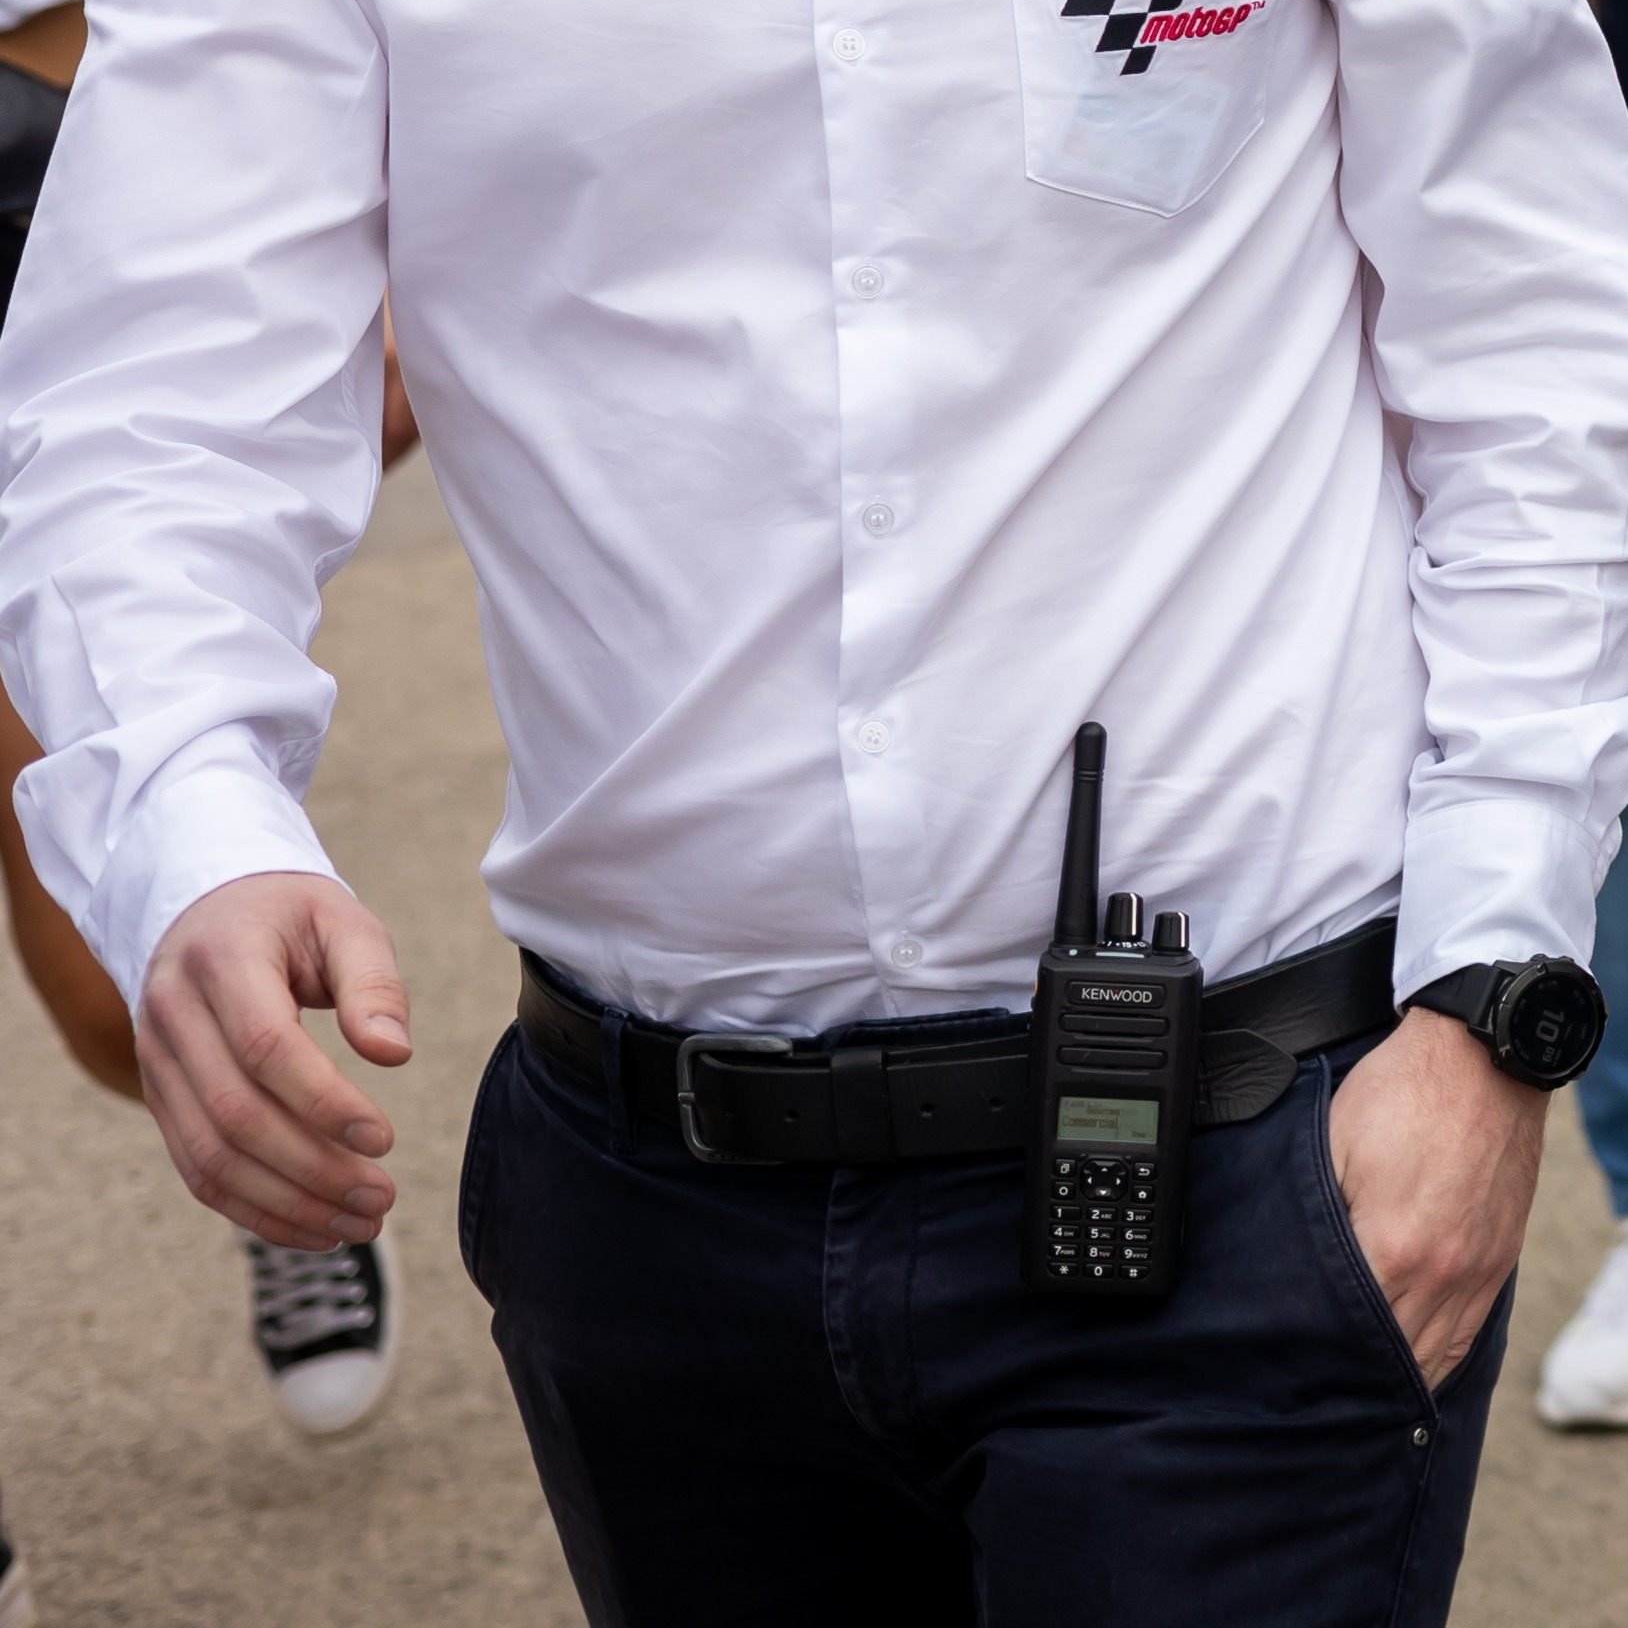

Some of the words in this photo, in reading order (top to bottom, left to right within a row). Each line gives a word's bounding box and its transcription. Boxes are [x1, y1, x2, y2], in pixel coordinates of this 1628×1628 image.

[1081, 987, 1153, 1003] KENWOOD
[1091, 1209, 1100, 1220] 2
[1126, 1211, 1134, 1221] 3
[1054, 1227, 1062, 1237] 4
[1090, 1228, 1099, 1239] 5
[1125, 1230, 1134, 1240] 6
[1054, 1245, 1062, 1256] 7
[1089, 1247, 1098, 1257] 8
[1124, 1248, 1133, 1259] 9
[1094, 1265, 1103, 1276] 0
